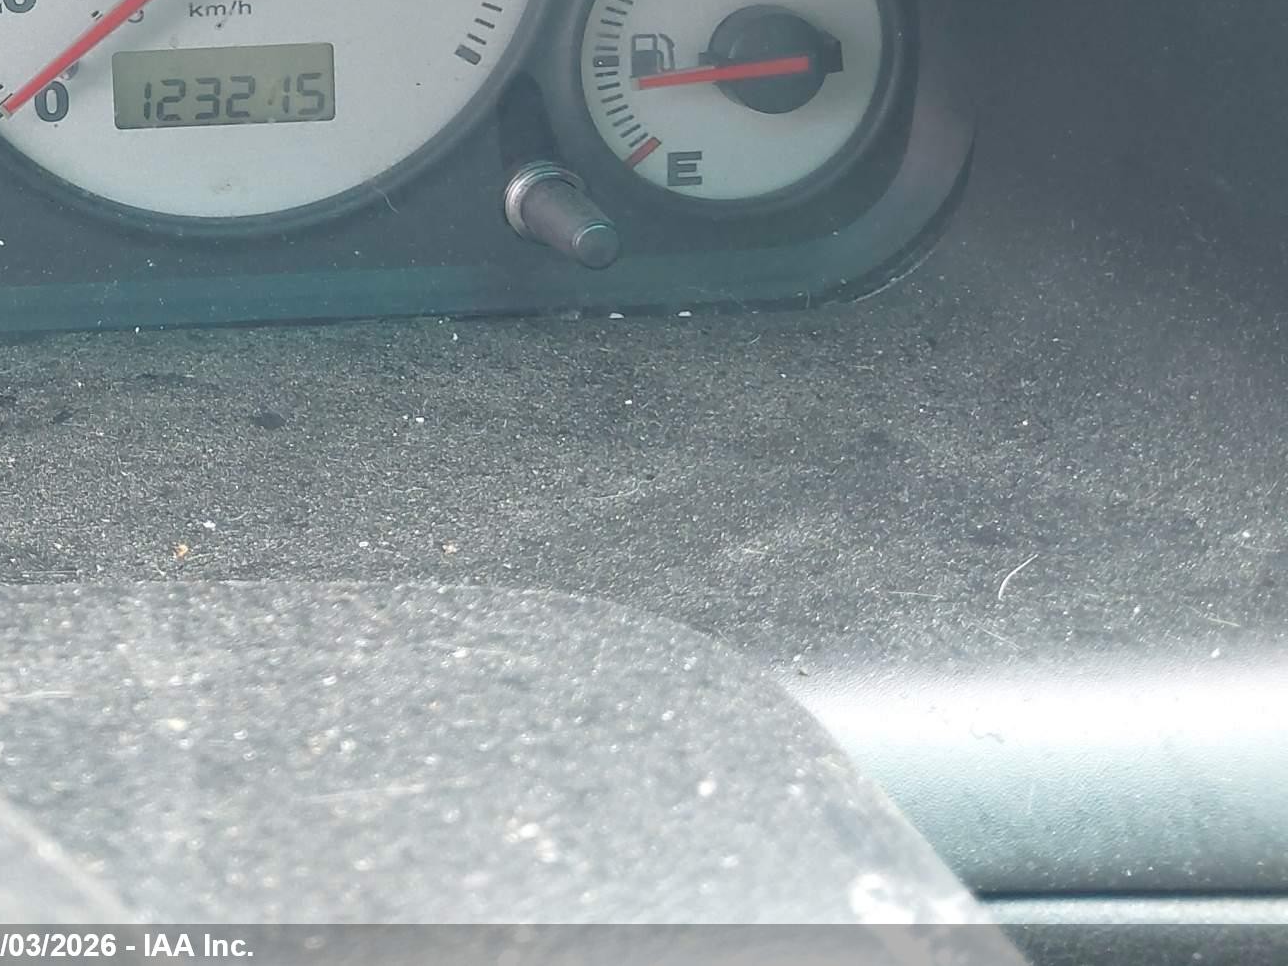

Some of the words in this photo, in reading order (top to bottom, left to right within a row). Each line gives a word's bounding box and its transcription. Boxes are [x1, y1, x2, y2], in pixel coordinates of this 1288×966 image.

[188, 0, 253, 18] km/h
[34, 81, 70, 123] 0
[666, 151, 703, 187] E
